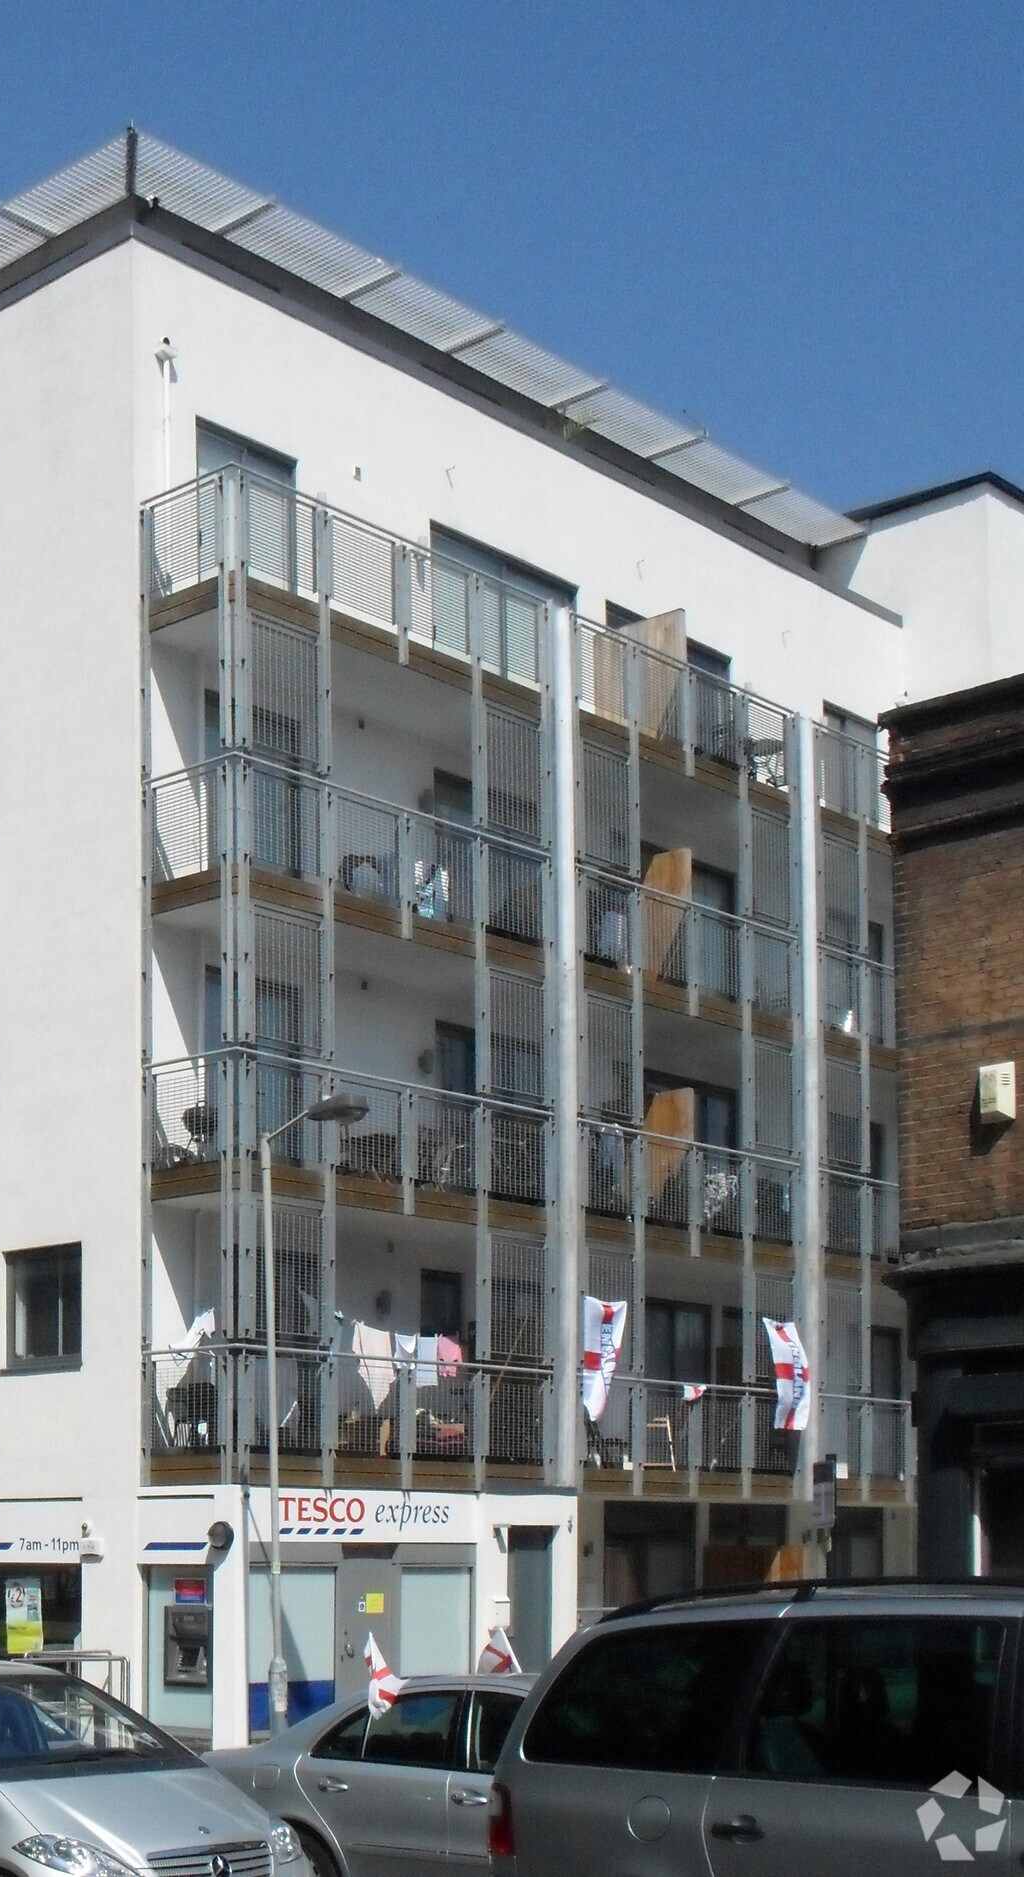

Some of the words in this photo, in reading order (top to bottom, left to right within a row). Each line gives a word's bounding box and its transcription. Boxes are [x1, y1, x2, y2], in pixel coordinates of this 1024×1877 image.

[278, 1496, 366, 1523] TESCO
[375, 1501, 450, 1532] express
[19, 1538, 42, 1551] 7am
[51, 1537, 80, 1554] 11pm
[11, 1587, 23, 1603] £2
